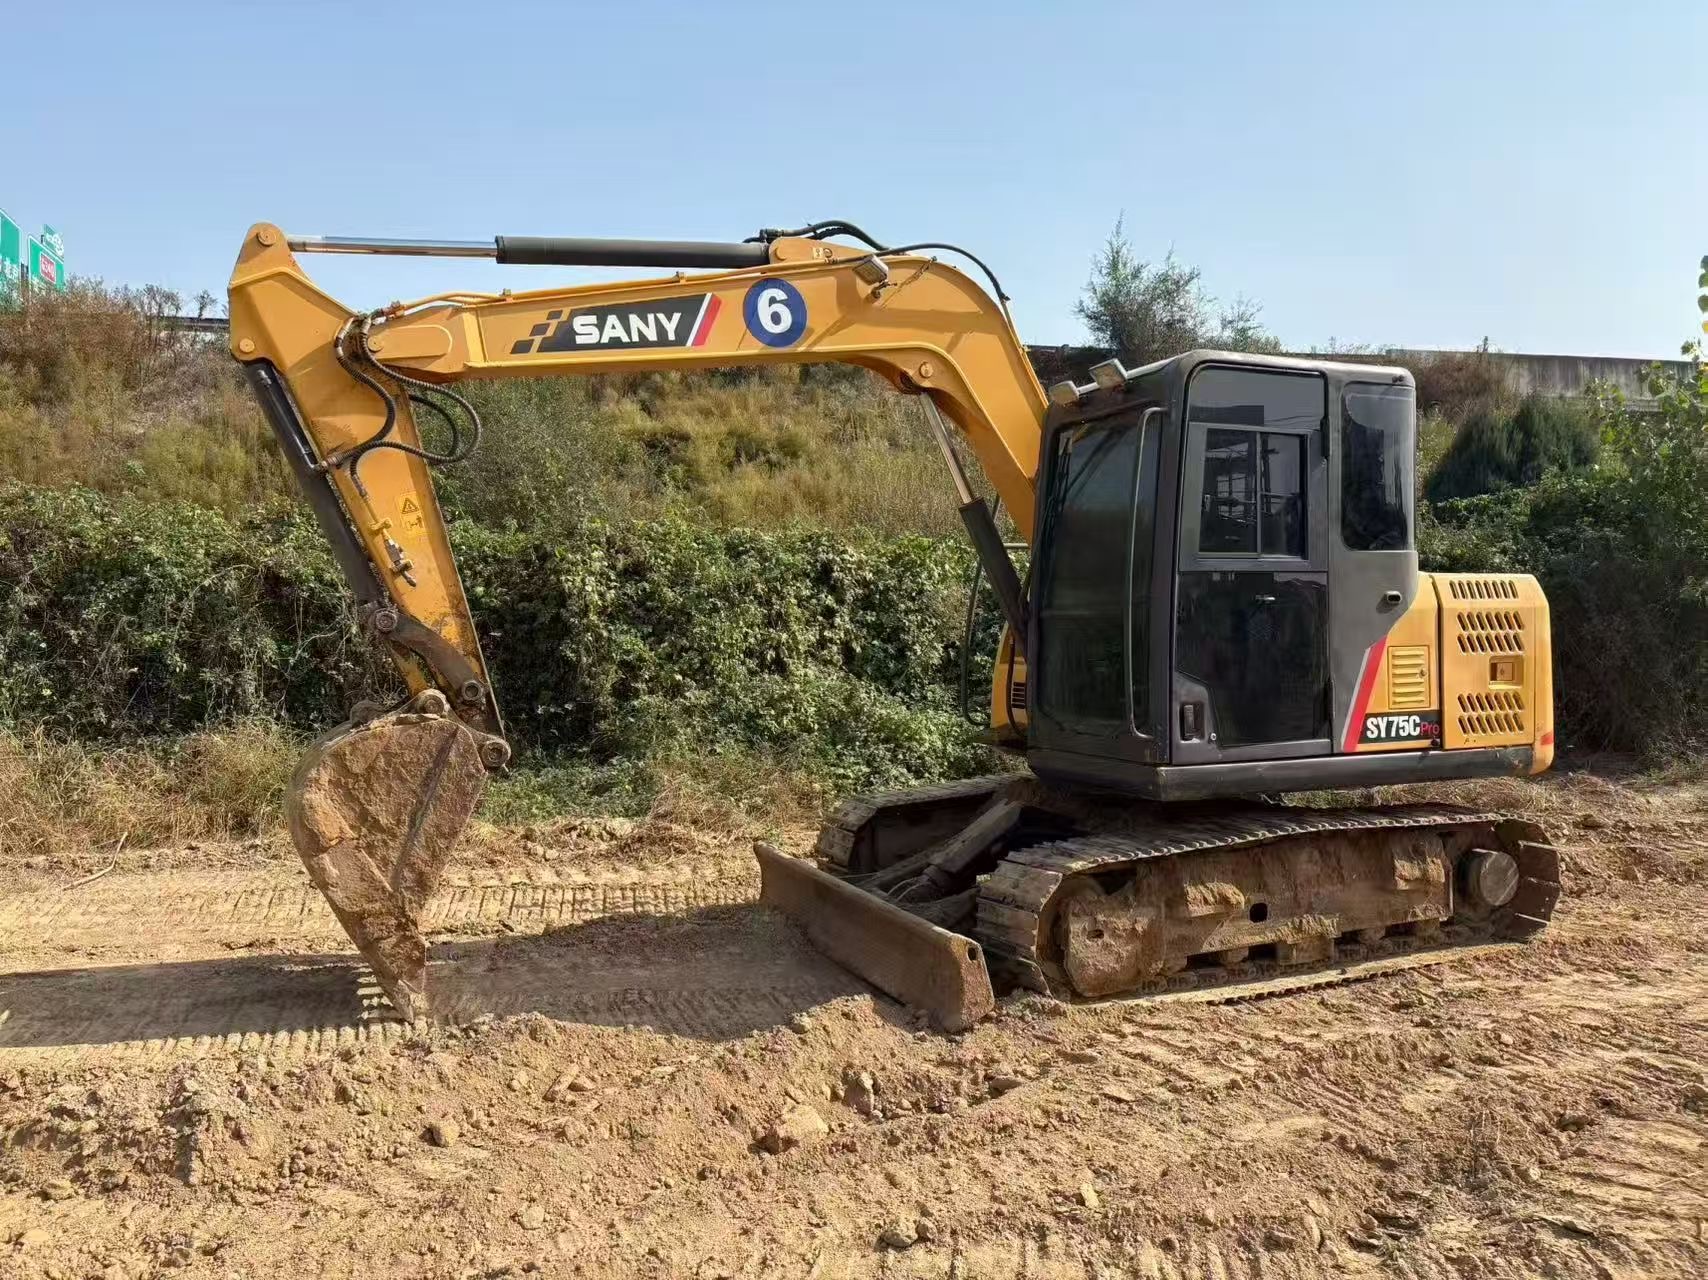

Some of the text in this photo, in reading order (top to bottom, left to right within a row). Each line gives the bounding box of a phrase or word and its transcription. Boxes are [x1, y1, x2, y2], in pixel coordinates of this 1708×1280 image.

[757, 288, 792, 335] 6
[572, 312, 682, 345] SANY
[1366, 715, 1420, 739] SY75C
